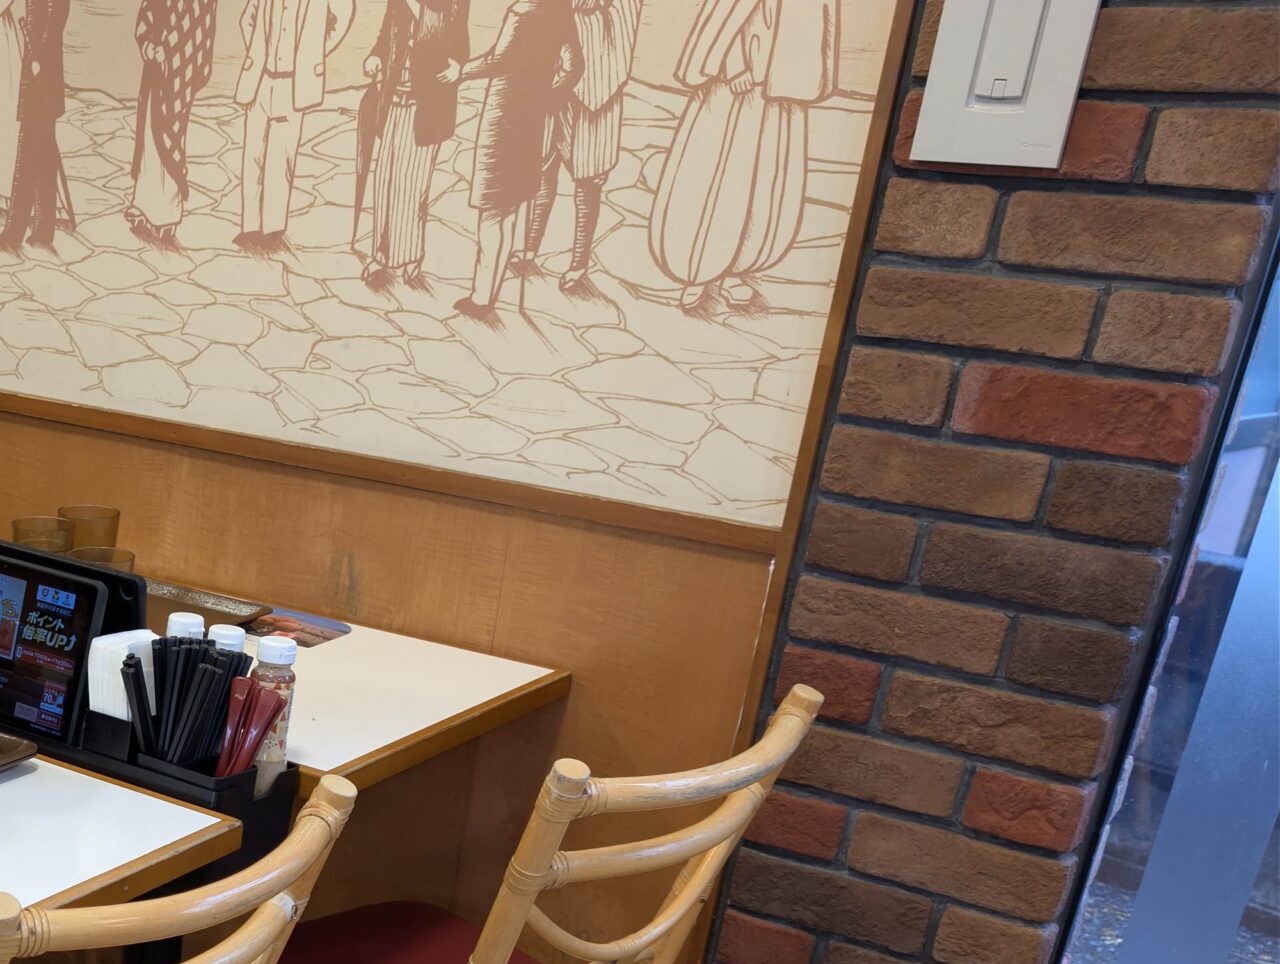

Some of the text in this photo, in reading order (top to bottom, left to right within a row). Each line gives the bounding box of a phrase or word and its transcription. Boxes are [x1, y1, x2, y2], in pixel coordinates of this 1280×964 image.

[26, 611, 65, 631] ポイント
[21, 624, 68, 648] 倍率UP
